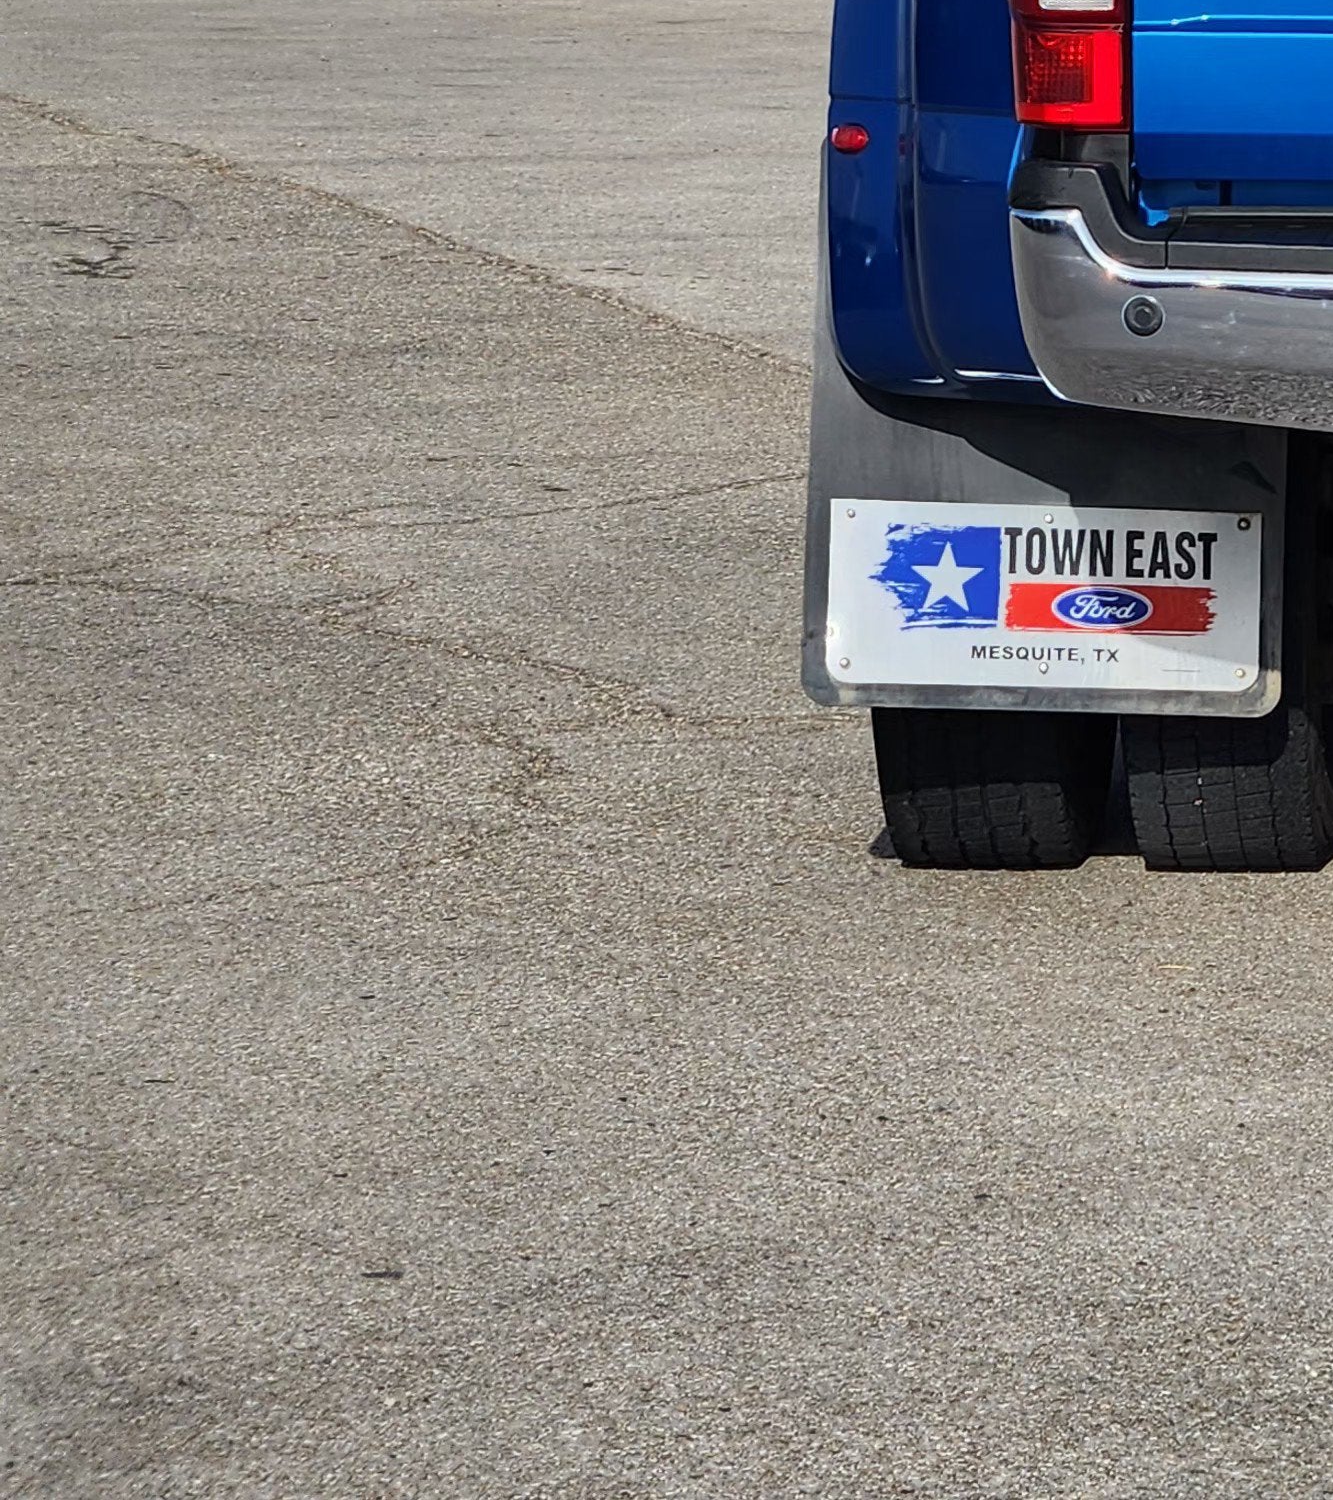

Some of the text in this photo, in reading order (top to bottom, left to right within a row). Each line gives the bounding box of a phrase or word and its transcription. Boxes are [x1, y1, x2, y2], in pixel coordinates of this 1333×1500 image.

[1004, 526, 1219, 581] TOWN EAST
[1069, 593, 1137, 620] Ford
[970, 645, 1120, 665] MESQUITE, TX
